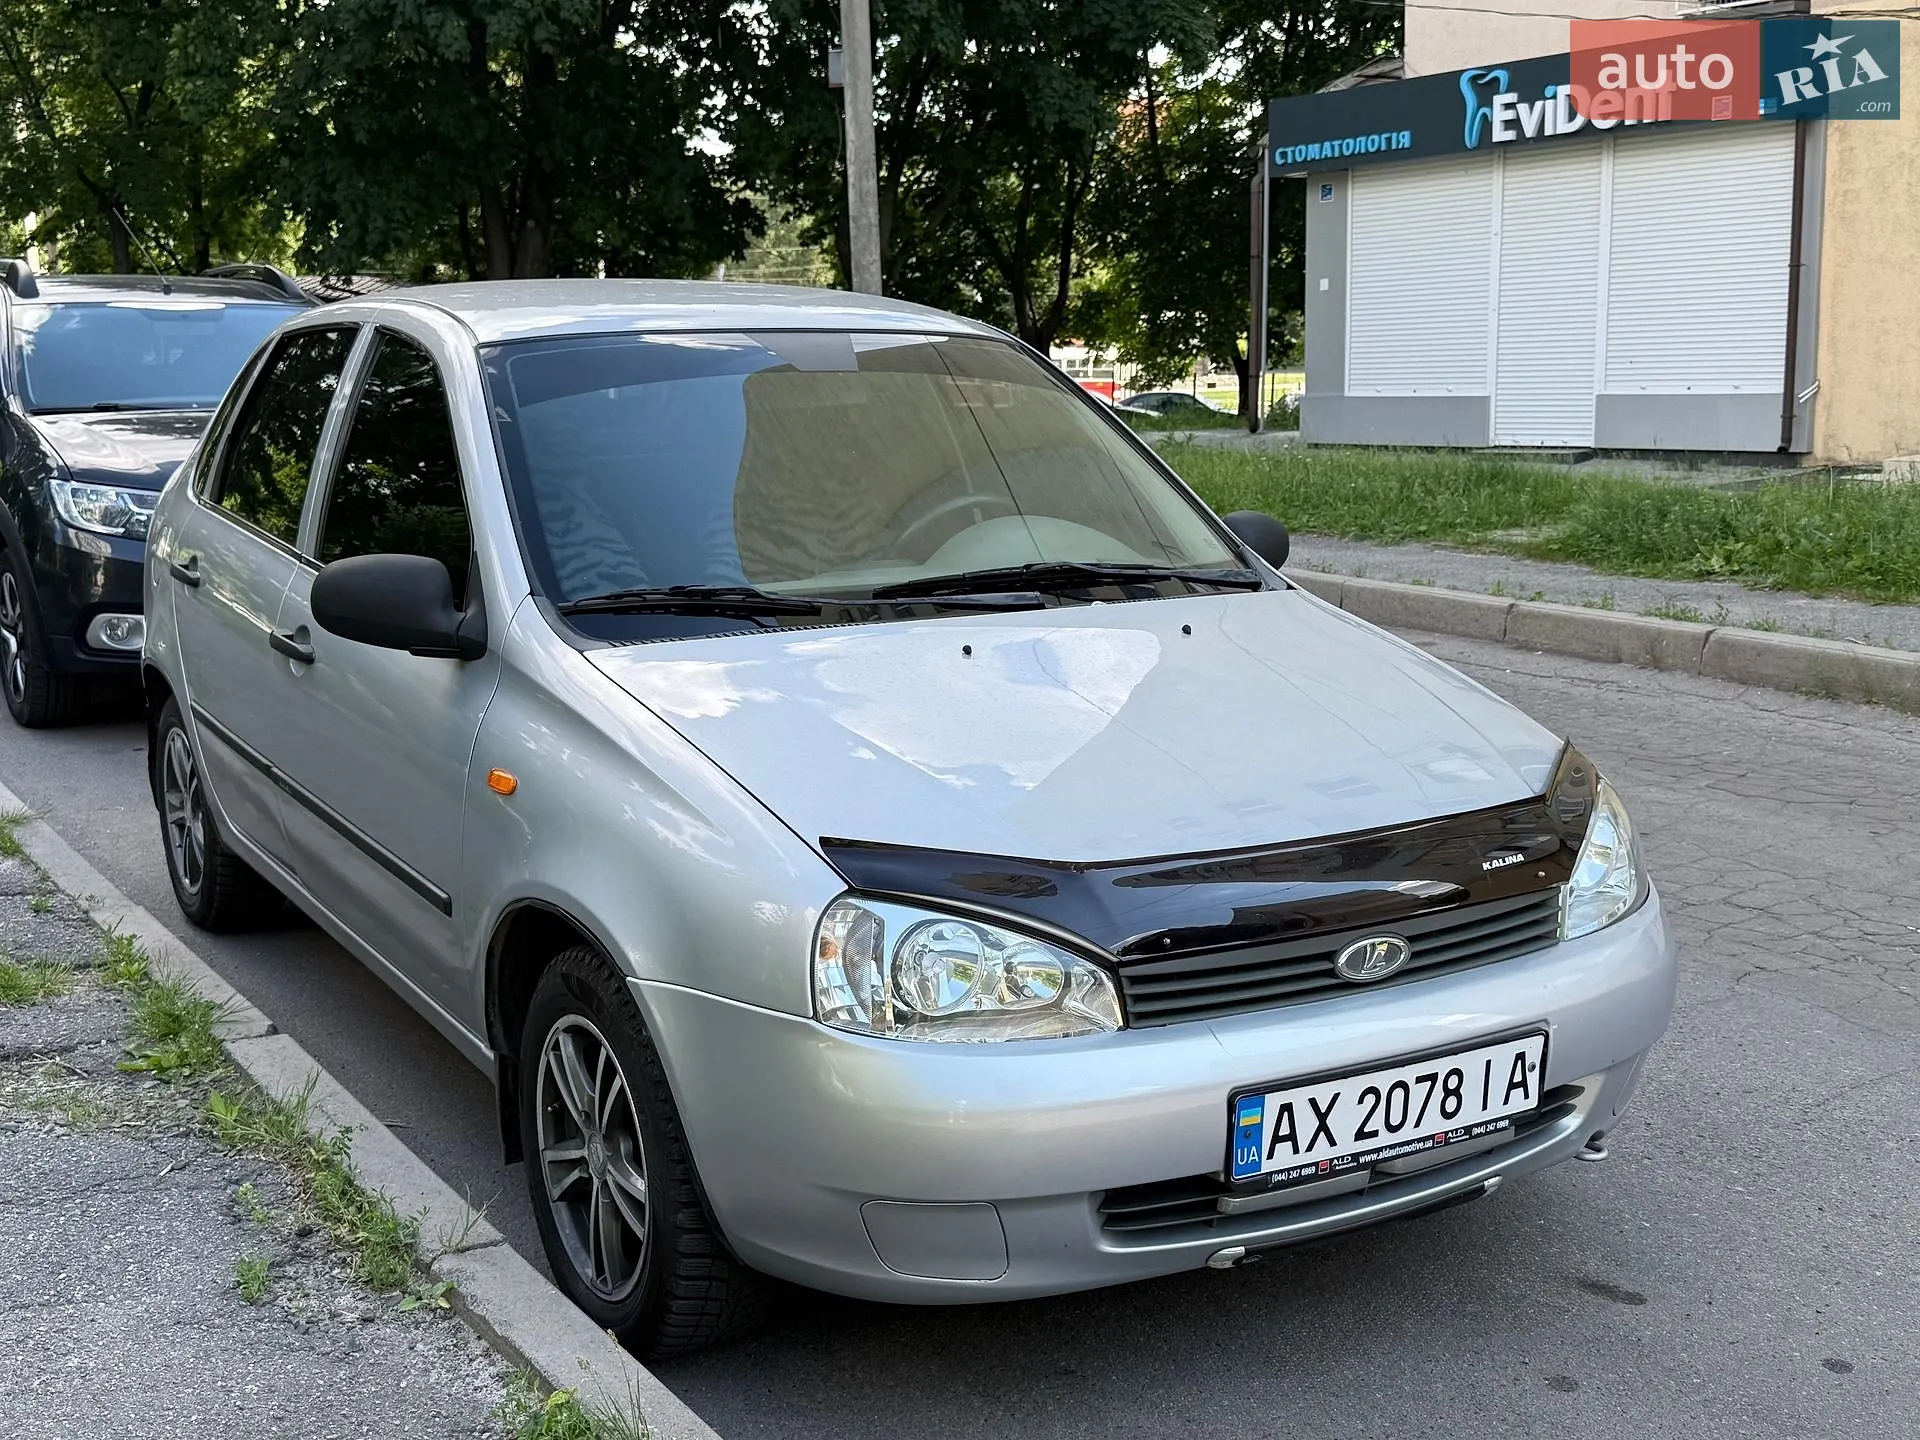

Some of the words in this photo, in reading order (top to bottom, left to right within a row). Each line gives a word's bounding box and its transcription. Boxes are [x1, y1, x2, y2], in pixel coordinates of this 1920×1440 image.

[1274, 130, 1412, 166] СТОМАТОЛОГІЯ
[1482, 853, 1525, 871] KALINA
[1266, 1091, 1341, 1161] AX
[1353, 1067, 1464, 1143] 2078
[1237, 1148, 1260, 1165] UA
[1271, 1171, 1288, 1183] (044)
[1289, 1169, 1300, 1179] 247
[1332, 1156, 1352, 1166] ALD
[1359, 1138, 1433, 1164] www.aldautomotive.ua
[1446, 1128, 1465, 1139] ALD
